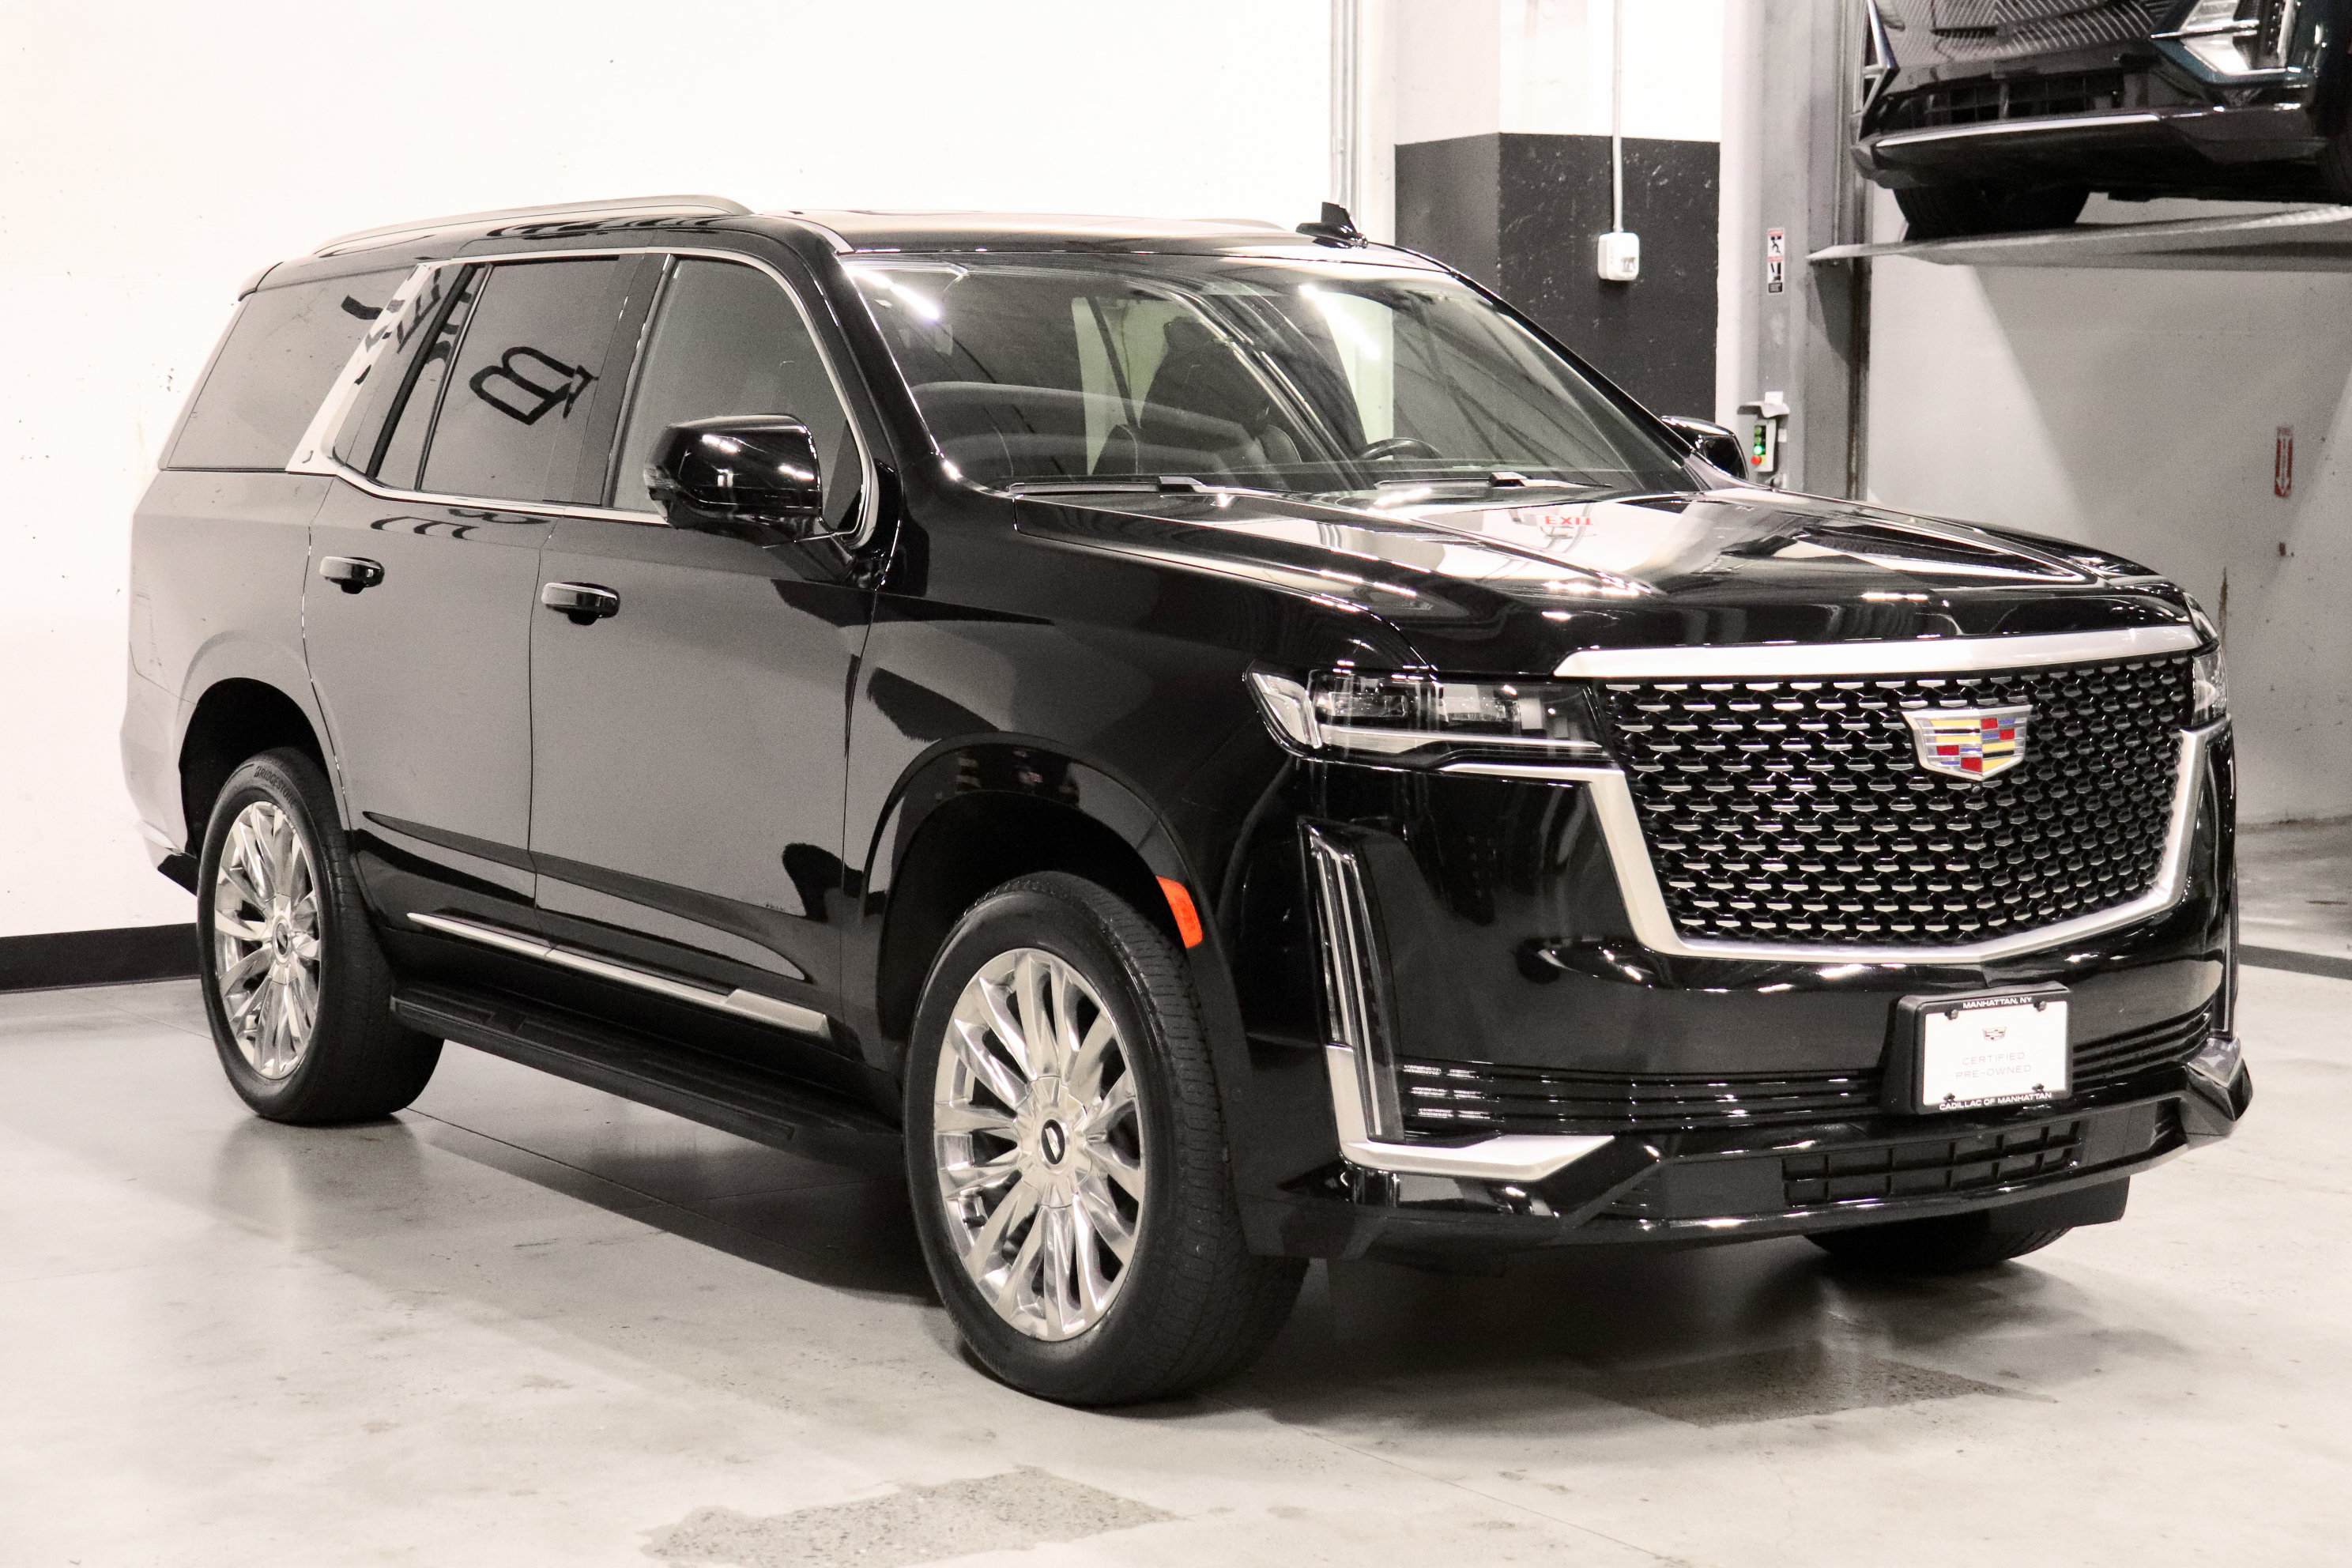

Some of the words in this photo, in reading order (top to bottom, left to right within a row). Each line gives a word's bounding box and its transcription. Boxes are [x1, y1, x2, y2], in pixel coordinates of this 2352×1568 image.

[1962, 997, 2018, 1009] MANHATTAN,
[1962, 1052, 2025, 1065] CERTIFIED
[1955, 1065, 2031, 1079] PRE-OWNED
[1939, 1099, 1982, 1110] CADILLAC
[1997, 1092, 2052, 1103] MANHATTAN
